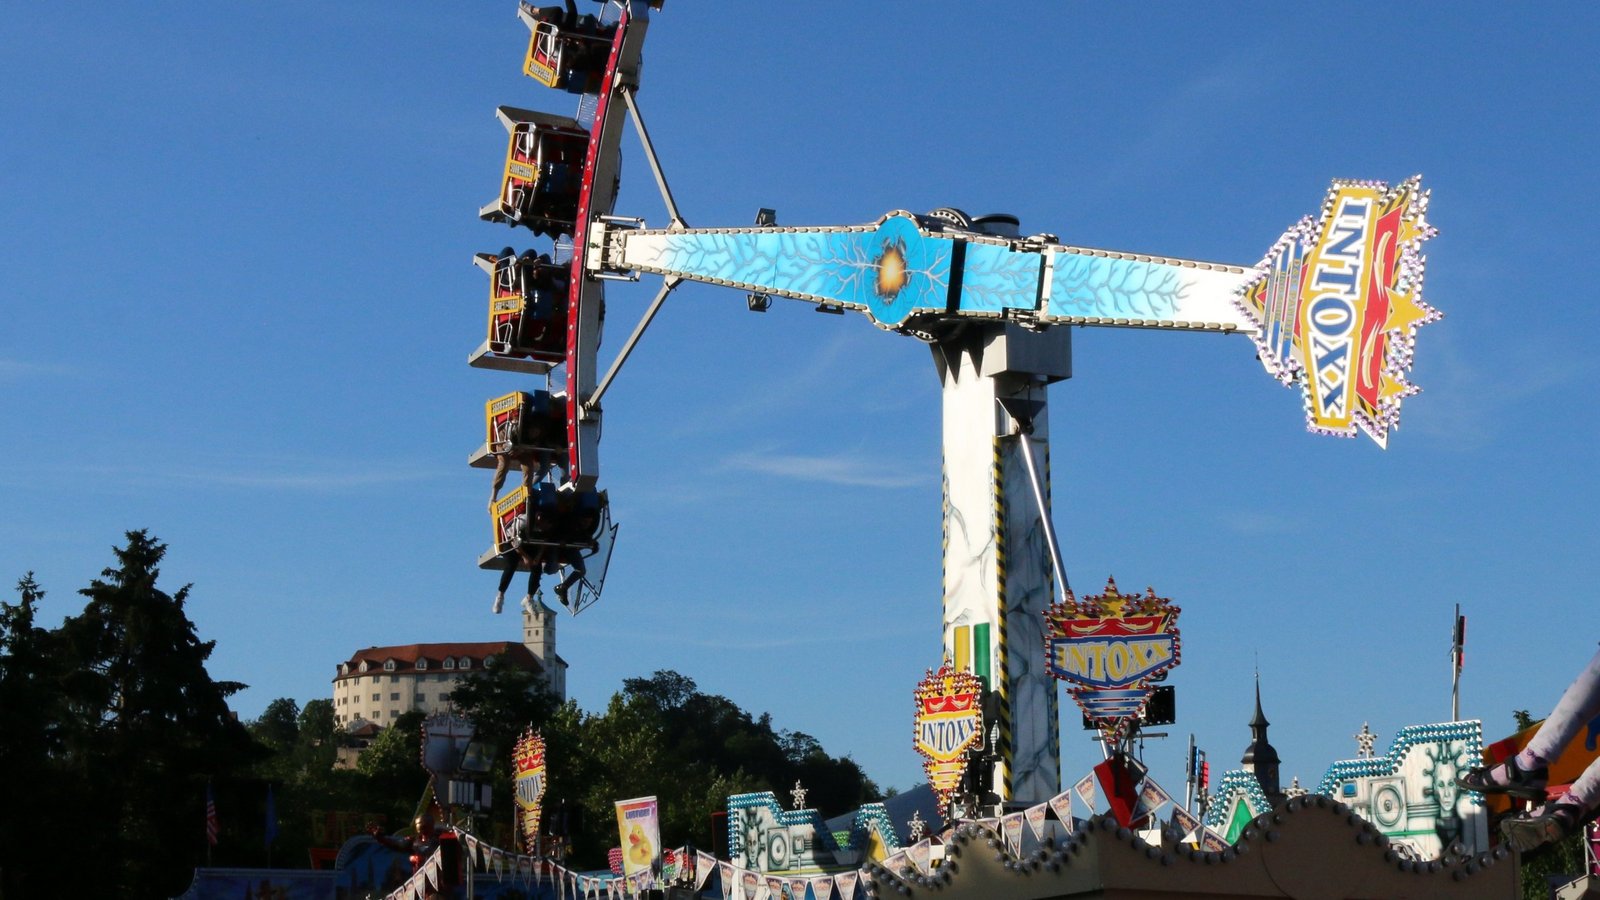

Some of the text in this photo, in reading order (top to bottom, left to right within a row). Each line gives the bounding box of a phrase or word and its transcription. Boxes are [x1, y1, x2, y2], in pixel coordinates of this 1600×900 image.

[1309, 200, 1368, 412] INTOXX
[1056, 642, 1171, 680] INTOXX
[922, 718, 976, 752] INTOXX
